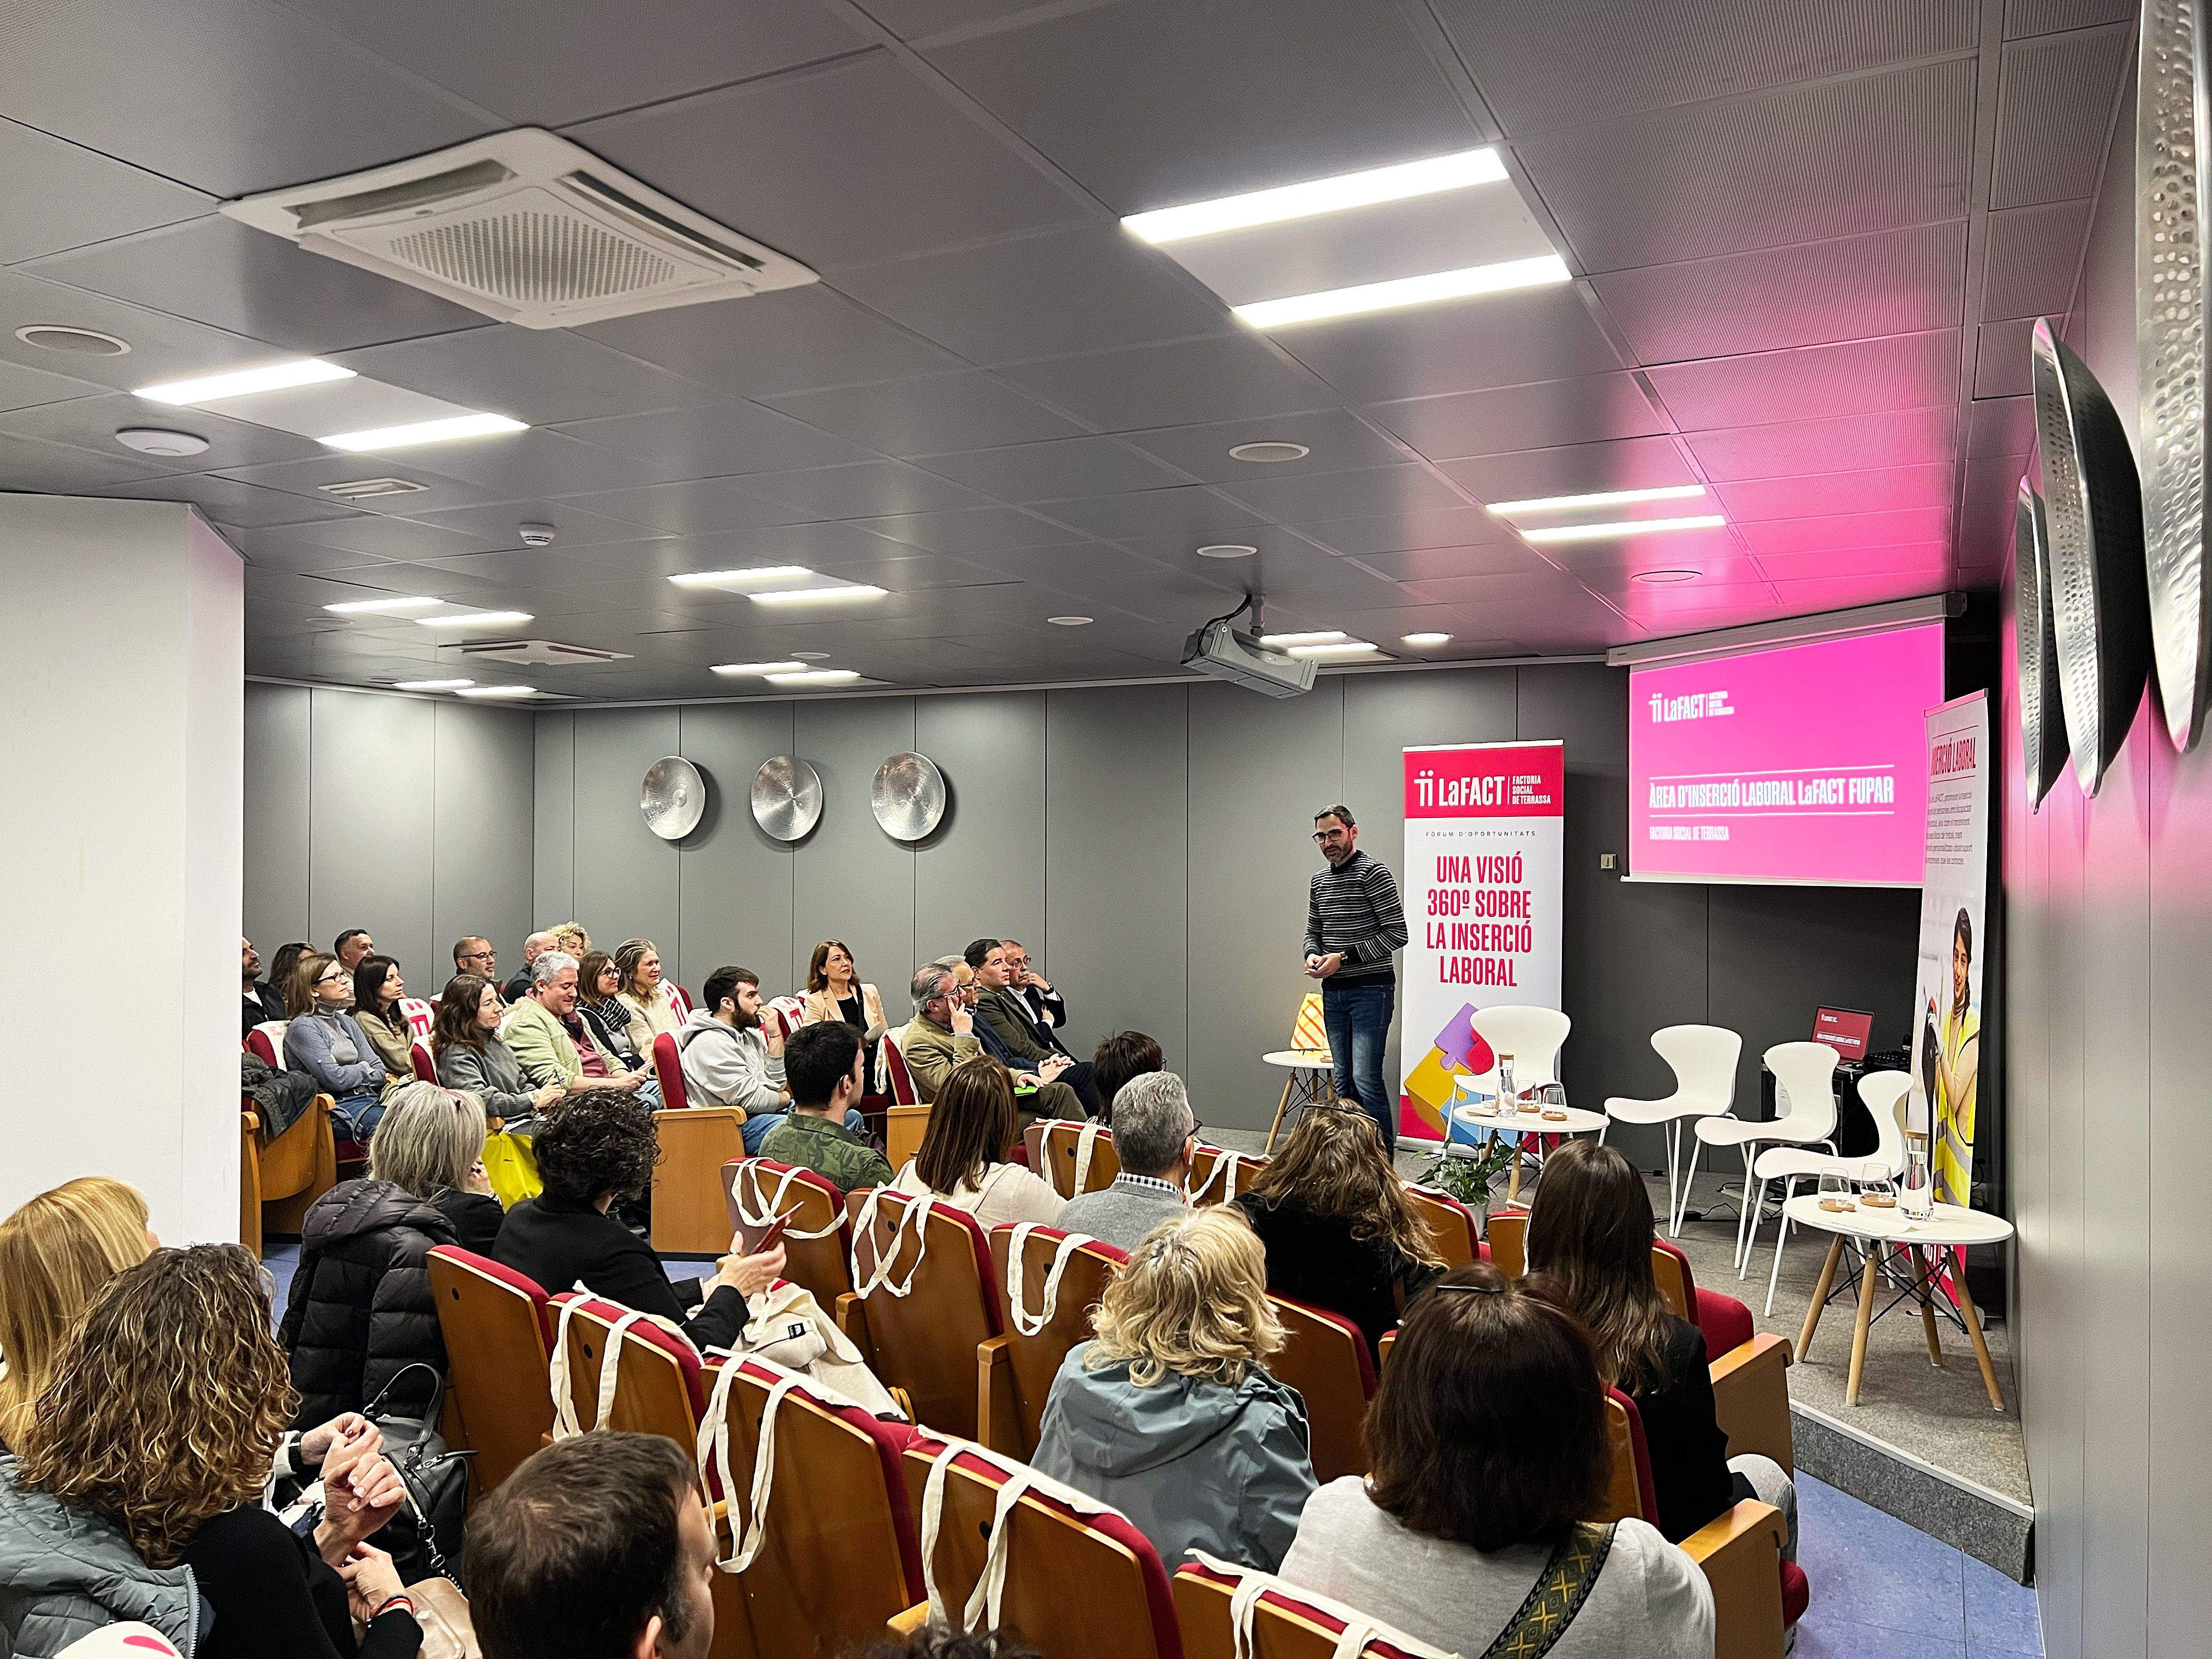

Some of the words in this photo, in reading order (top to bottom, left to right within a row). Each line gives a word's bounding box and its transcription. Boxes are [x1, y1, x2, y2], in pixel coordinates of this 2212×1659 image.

[1664, 693, 1706, 722] LaFACT
[1438, 776, 1505, 806] LaFACT
[1513, 775, 1542, 785] FACTORIA
[1512, 785, 1533, 795] SOCIAL
[1512, 795, 1520, 805] DE
[1520, 795, 1551, 804] TERRASSA
[1649, 782, 1676, 808] ÀREA
[1678, 778, 1740, 808] D'INSERCIÓ
[1742, 780, 1796, 806] LABORAL
[1798, 778, 1846, 805] LaFACT
[1849, 776, 1894, 804] FUPAR
[1701, 826, 1729, 841] TERRASSA
[1437, 856, 1471, 883] UNA
[1476, 851, 1522, 884] VISIÓ
[1427, 889, 1470, 917] 360º
[1475, 890, 1531, 918] SOBRE
[1426, 922, 1446, 950] LA
[1452, 919, 1532, 953] INSERCIÓ
[1440, 956, 1517, 987] LABORAL
